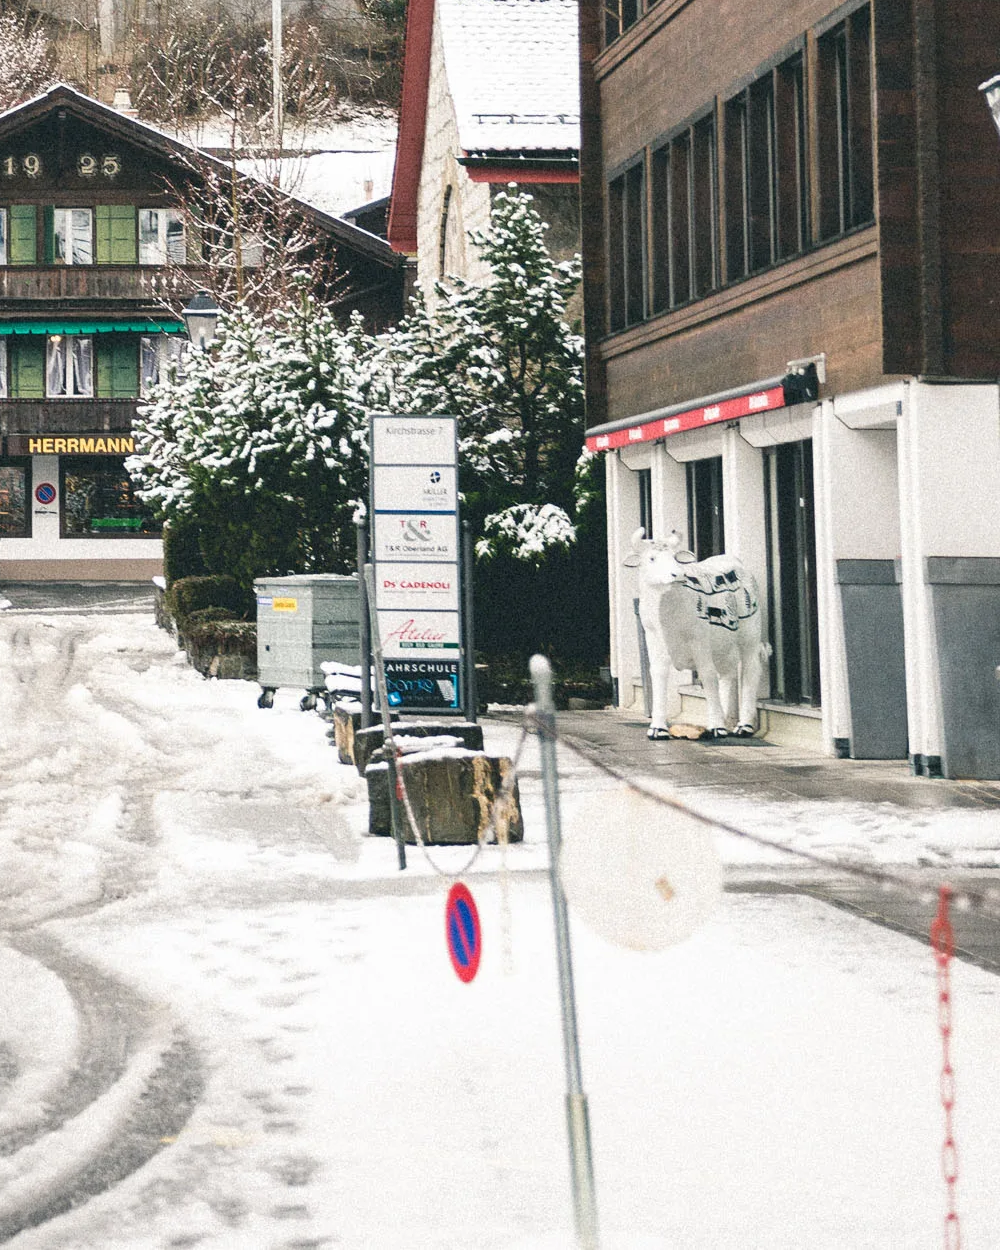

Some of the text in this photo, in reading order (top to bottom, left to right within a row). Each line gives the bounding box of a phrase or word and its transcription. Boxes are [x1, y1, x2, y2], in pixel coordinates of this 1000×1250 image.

[4, 154, 119, 175] 19 25
[386, 426, 434, 436] Kirchstrasse
[29, 438, 134, 453] HERRMANN
[384, 664, 457, 673] AHRSCHULE
